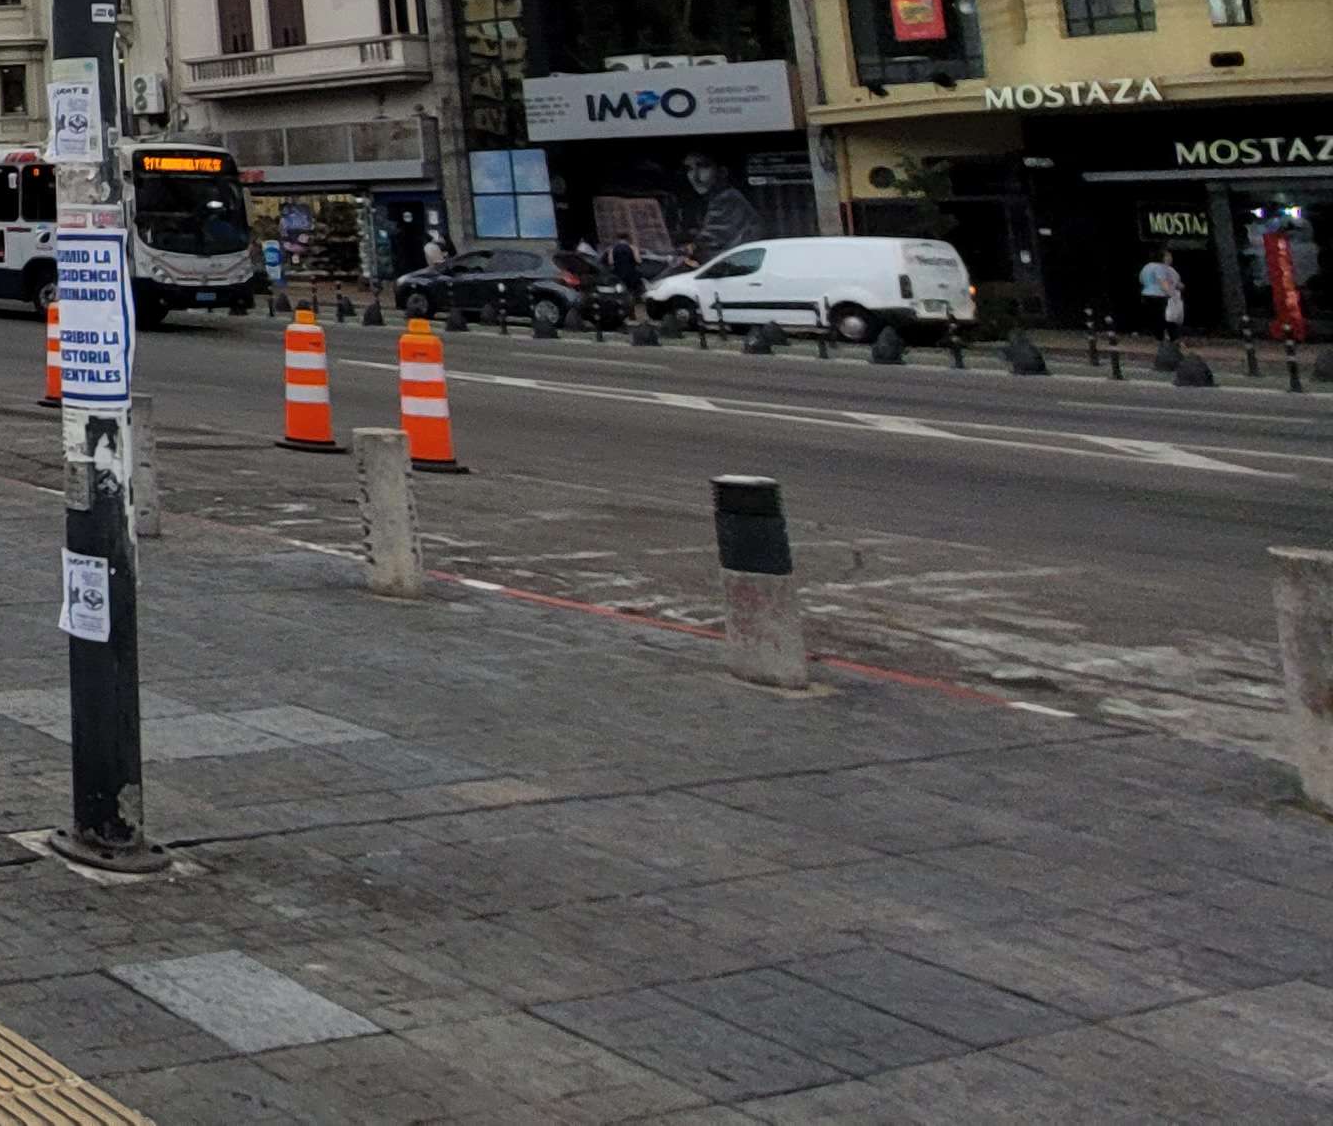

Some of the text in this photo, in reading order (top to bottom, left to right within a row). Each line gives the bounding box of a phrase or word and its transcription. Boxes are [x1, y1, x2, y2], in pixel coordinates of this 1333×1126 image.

[586, 87, 696, 122] IMPO
[985, 77, 1163, 111] MOSTAZA
[1174, 135, 1333, 165] MOSTAZ
[94, 250, 111, 263] LA
[103, 331, 119, 344] LA
